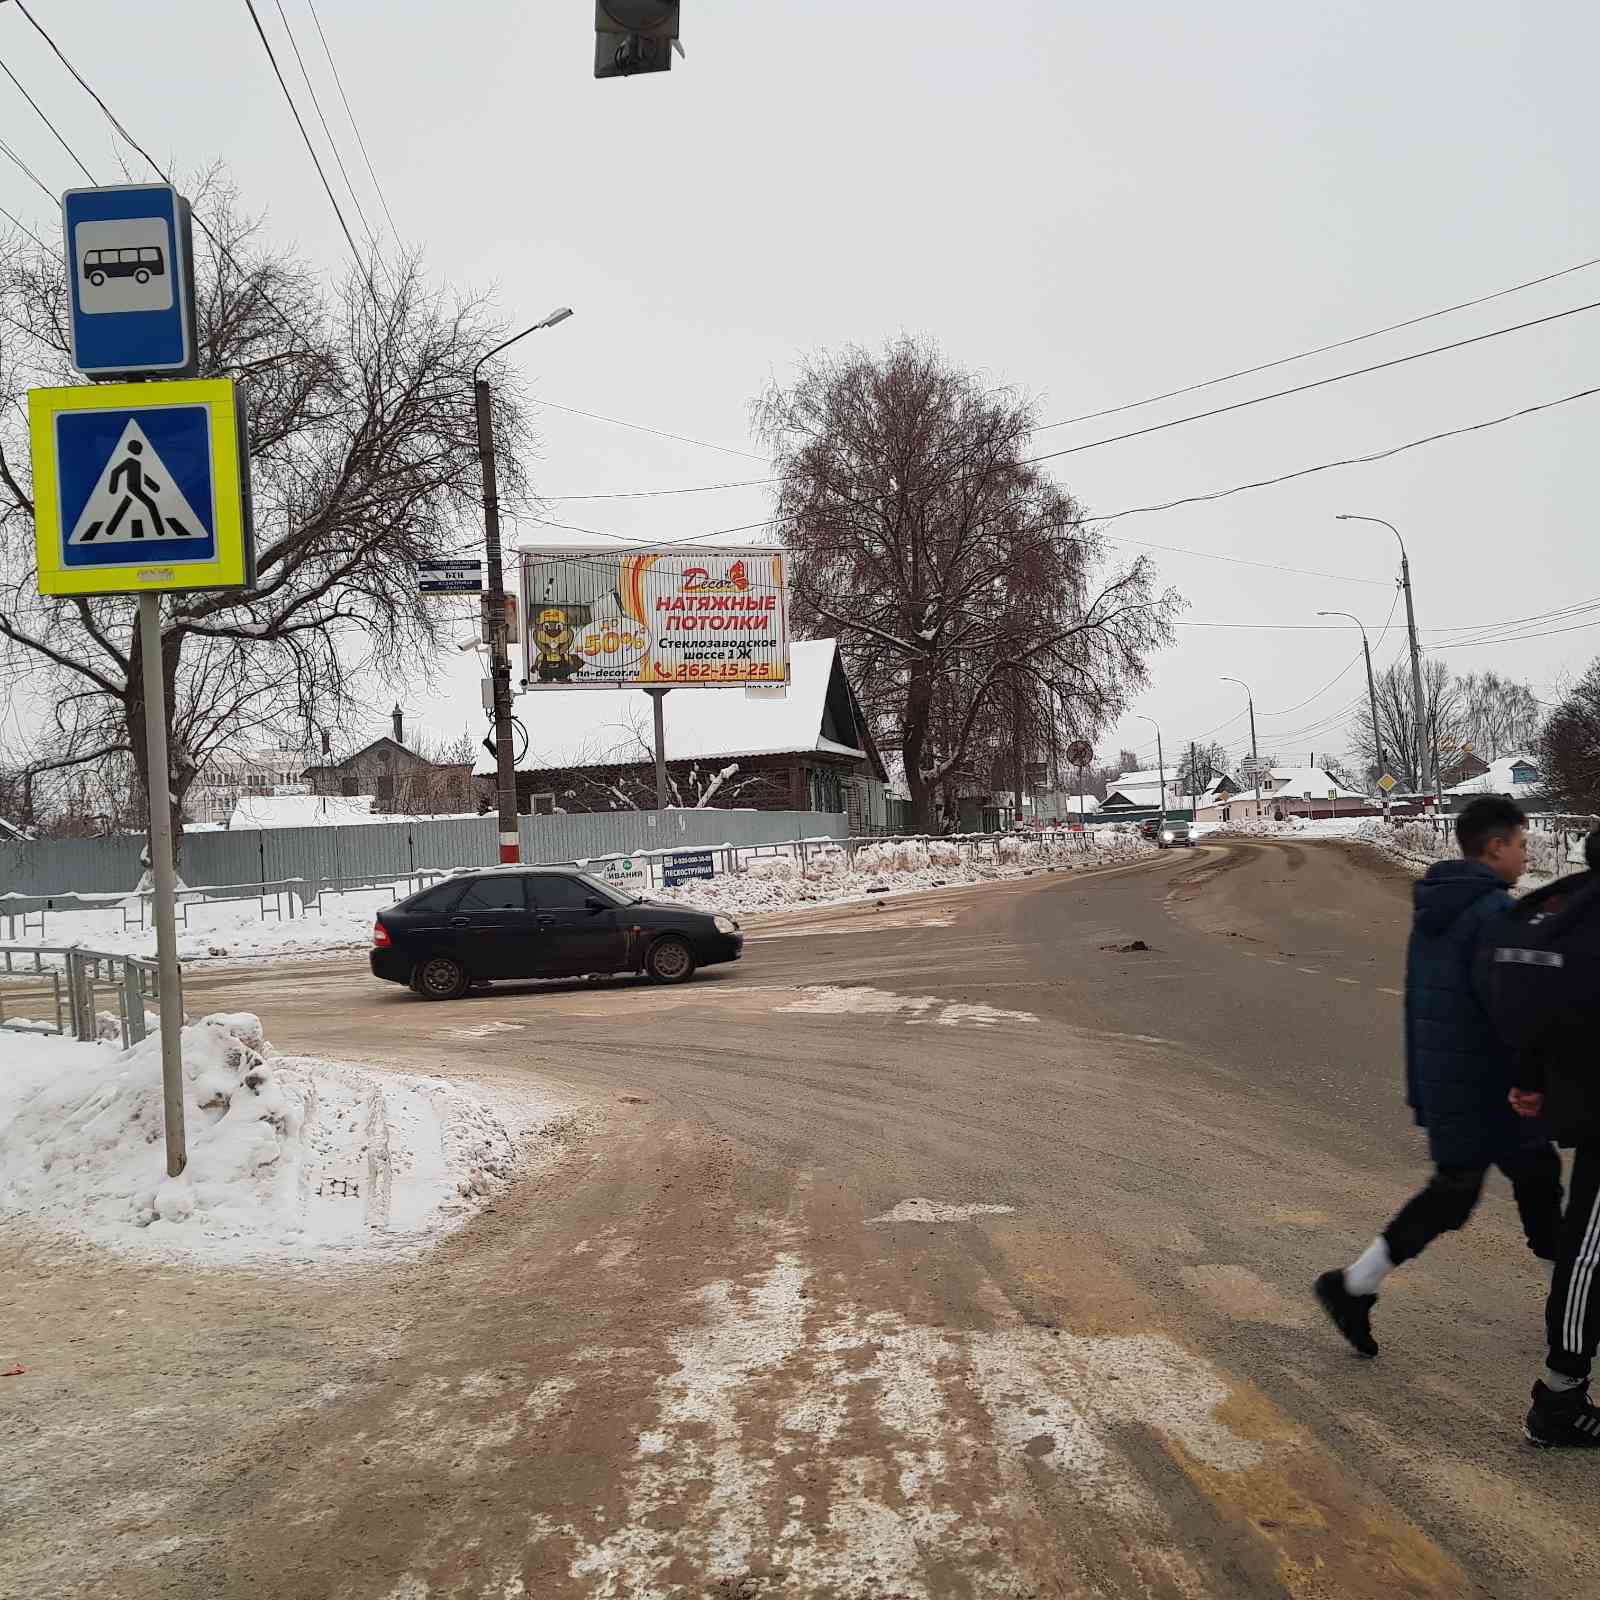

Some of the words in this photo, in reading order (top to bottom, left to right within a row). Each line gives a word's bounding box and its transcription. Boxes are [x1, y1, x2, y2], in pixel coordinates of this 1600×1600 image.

[682, 567, 732, 589] Decor
[656, 595, 776, 611] НАТЯЖНЫЕ
[666, 615, 769, 631] ПОТОЛКИ
[658, 637, 777, 649] Стеклозаводское
[683, 650, 725, 660] шоссе
[727, 650, 734, 659] 1
[736, 648, 753, 660] Ж
[576, 669, 640, 678] nn-decor.ru
[676, 662, 770, 677] 262-15-25
